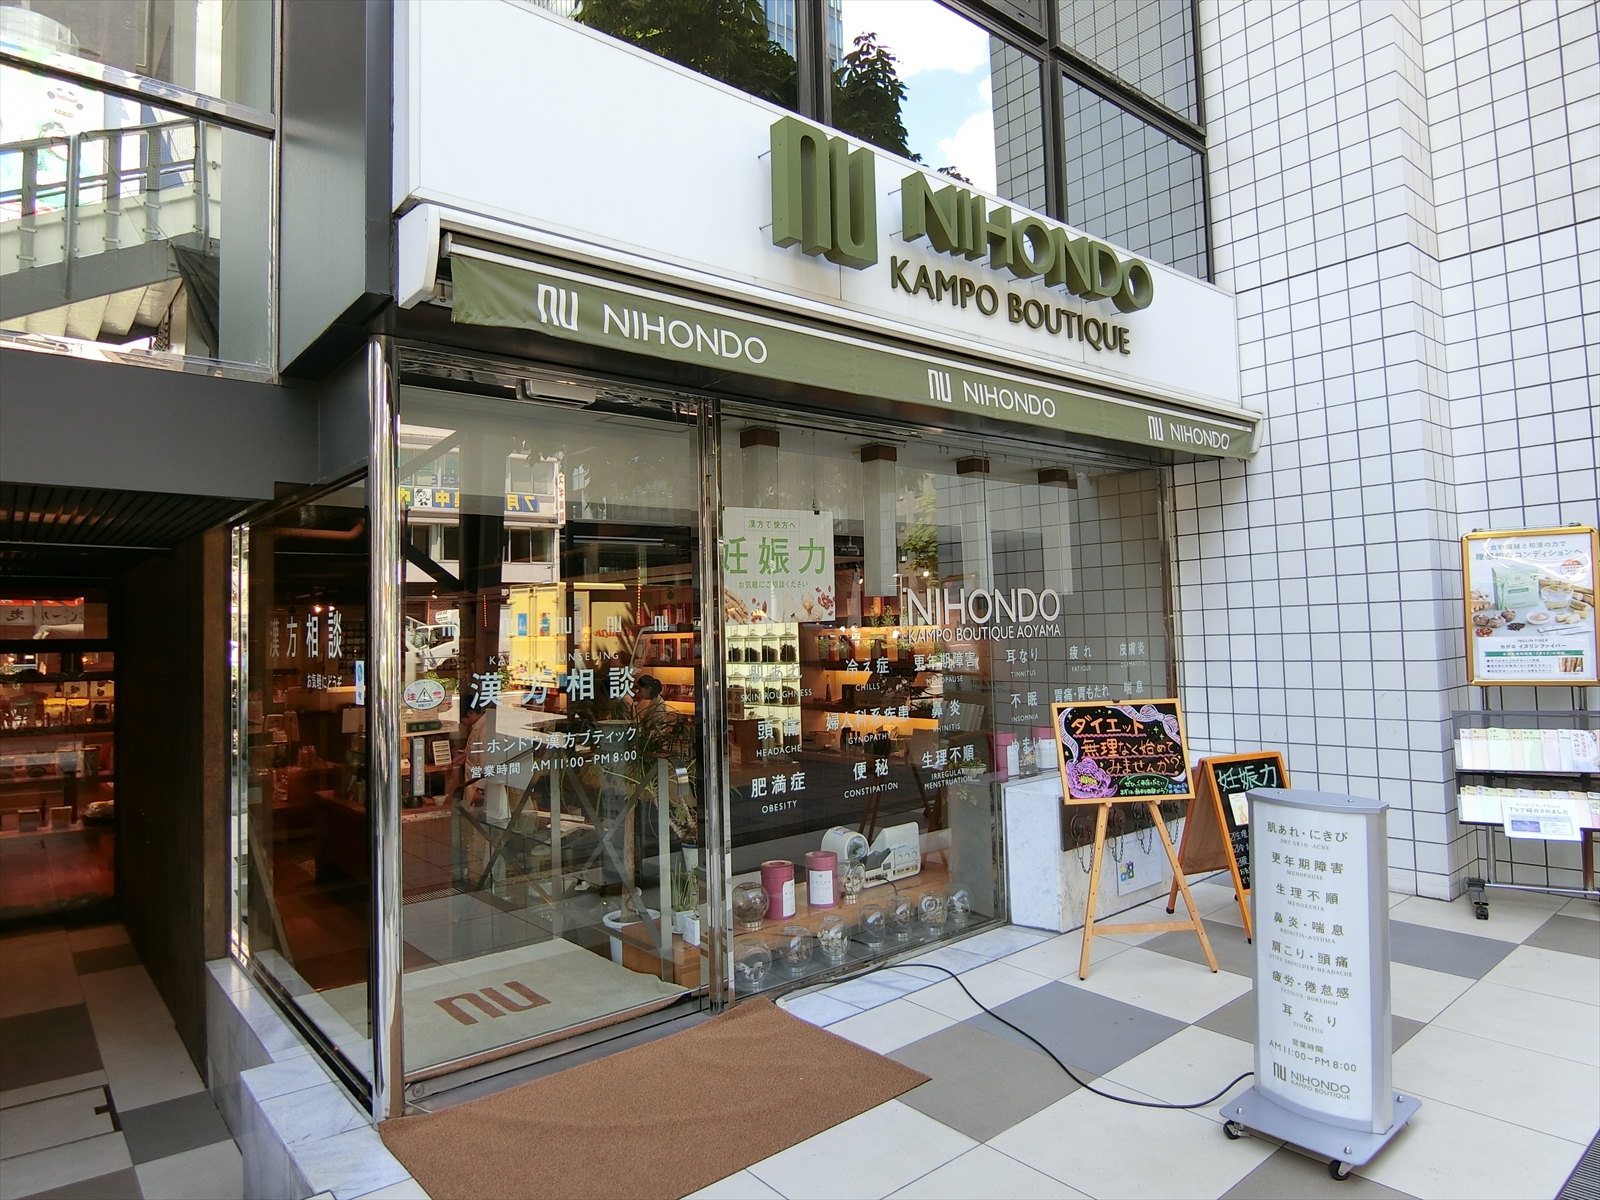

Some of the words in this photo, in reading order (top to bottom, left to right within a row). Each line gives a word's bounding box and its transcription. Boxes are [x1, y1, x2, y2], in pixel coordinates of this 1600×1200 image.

[901, 171, 1154, 314] NIHONDO
[890, 256, 998, 316] KAMPO
[1007, 292, 1131, 355] BOUTIQUE
[603, 303, 768, 364] NIHONDO
[962, 380, 1057, 419] NIHONDO
[1170, 423, 1230, 450] NIHONDO
[748, 519, 796, 530] 漢方で快方へ
[723, 536, 826, 575] 妊娠力
[738, 580, 808, 589] お気軽にご相談ください
[907, 588, 1061, 626] NIHONDO
[270, 610, 342, 659] 漢方相談
[908, 628, 953, 644] KAMPO
[957, 625, 1014, 642] BOUTIQUE
[1016, 623, 1061, 638] AOYAMA
[1006, 647, 1038, 664] 耳なり
[1069, 645, 1092, 659] 疲れ
[1119, 641, 1145, 656] 皮膚炎
[845, 657, 890, 676] 冷え症
[913, 651, 976, 672] 更年期障害
[307, 673, 343, 690] お気軽にどうぞ
[750, 663, 803, 684] 肌あれ
[926, 675, 963, 685] MENOPAUSE
[1010, 669, 1036, 678] TINNITUS
[470, 666, 636, 710] 漢方相談
[740, 692, 761, 703] SKIN
[764, 688, 813, 701] ROUGHNESS
[855, 682, 880, 692] CHILLS
[1054, 685, 1110, 703] 胃痛・胃もたれ
[1123, 680, 1144, 695] 喘息
[931, 699, 961, 718] 鼻炎
[1010, 691, 1038, 709] 不眠
[826, 705, 909, 732] 婦人科系疾患
[933, 722, 961, 733] RHINITIS
[1011, 714, 1039, 723] INSOMNIA
[1071, 714, 1145, 735] ダイエット
[757, 717, 800, 741] 頭痛
[848, 731, 891, 745] GYNOPATHY
[470, 727, 637, 755] ニホンドウ漢方ブティック
[1081, 738, 1174, 757] 無理なく始めて
[756, 744, 802, 758] HEADACHE
[921, 744, 975, 769] 生理不順
[470, 761, 521, 779] 営業時間
[853, 758, 889, 782] 便秘
[931, 768, 966, 781] IRREGULAR
[1218, 764, 1277, 792] 妊娠力
[751, 771, 807, 799] 肥満症
[844, 782, 899, 799] CONSTIPATION
[924, 775, 973, 790] MENSTRUATION
[761, 799, 798, 814] OBESITY
[1509, 807, 1569, 815] TVで紹介されました
[1267, 821, 1348, 843] 肌あれ・にきび
[1271, 851, 1344, 875] 更年期障害
[1287, 869, 1324, 881] MENOPAUSE
[1276, 883, 1339, 905] 生理不順
[1287, 900, 1325, 912] MENOXENIA
[1273, 911, 1344, 937] 鼻炎・喘息
[1271, 939, 1349, 969] 肩こり・頭痛
[1272, 970, 1350, 999] 疲労・倦怠感
[1282, 1002, 1336, 1028] 耳なり
[1293, 1021, 1324, 1034] TINNITUS
[1292, 1038, 1324, 1054] 営業時間
[1290, 1070, 1351, 1094] NIHONDO
[1291, 1079, 1312, 1092] KAMPO
[1314, 1087, 1351, 1101] BOUTIQUE
